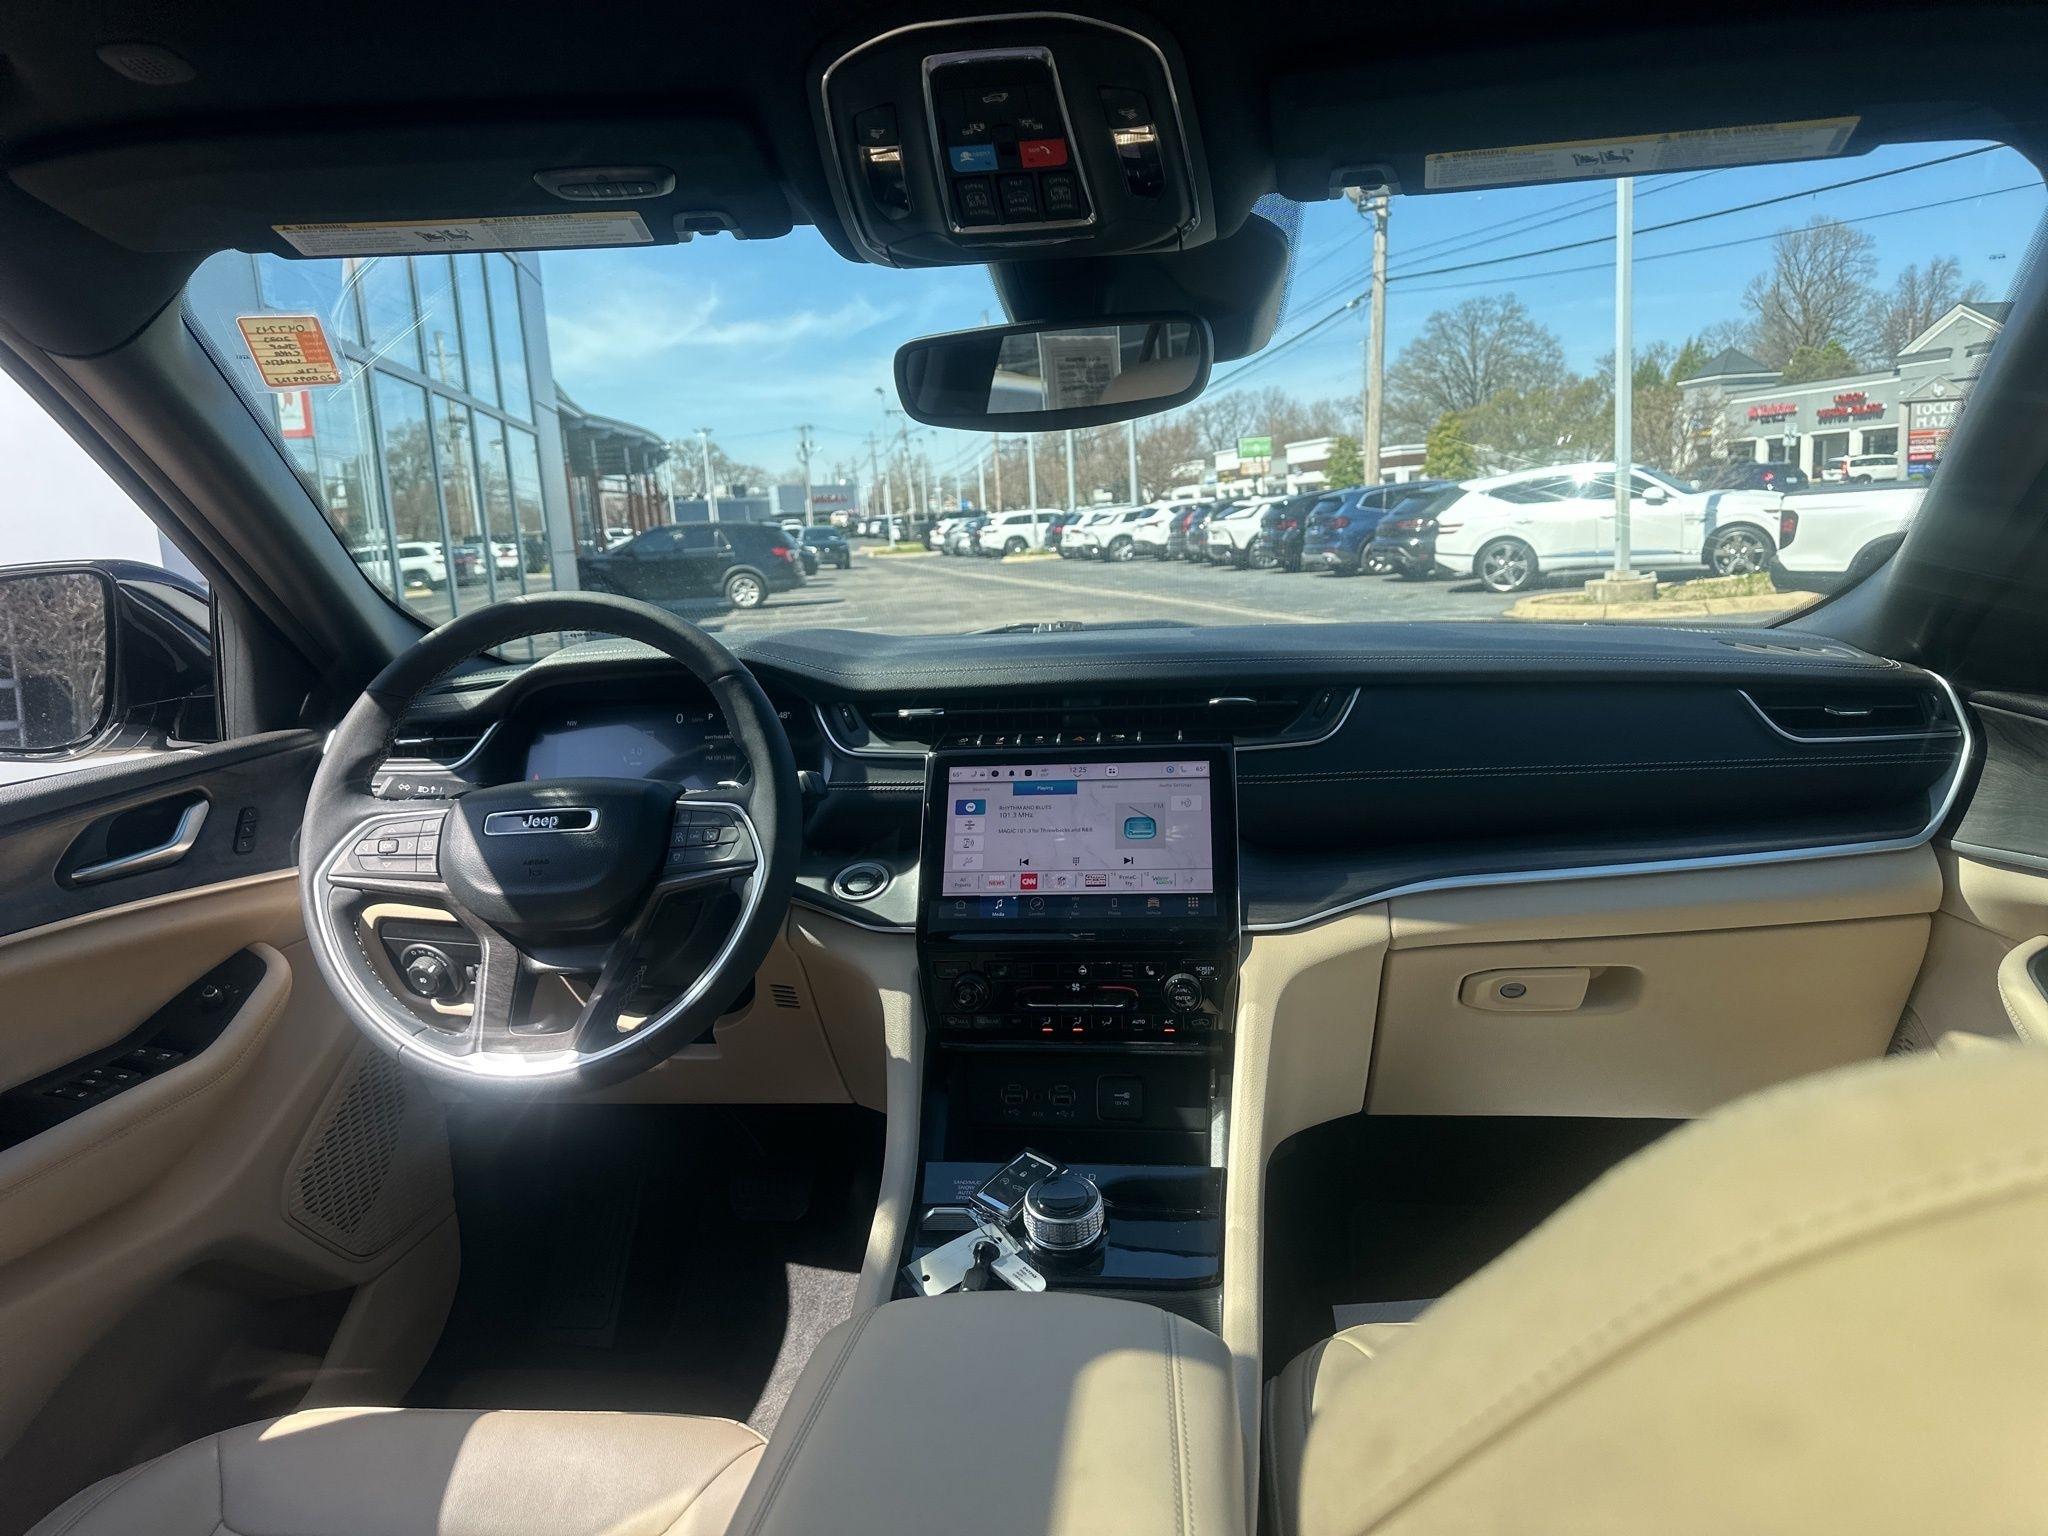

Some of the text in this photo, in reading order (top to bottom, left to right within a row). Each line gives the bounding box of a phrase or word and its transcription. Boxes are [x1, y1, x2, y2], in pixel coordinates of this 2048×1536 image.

[676, 713, 684, 724] 0
[522, 814, 560, 829] Jeep
[988, 880, 1005, 888] NEWS
[1022, 878, 1036, 886] CNN
[1088, 1173, 1097, 1181] D
